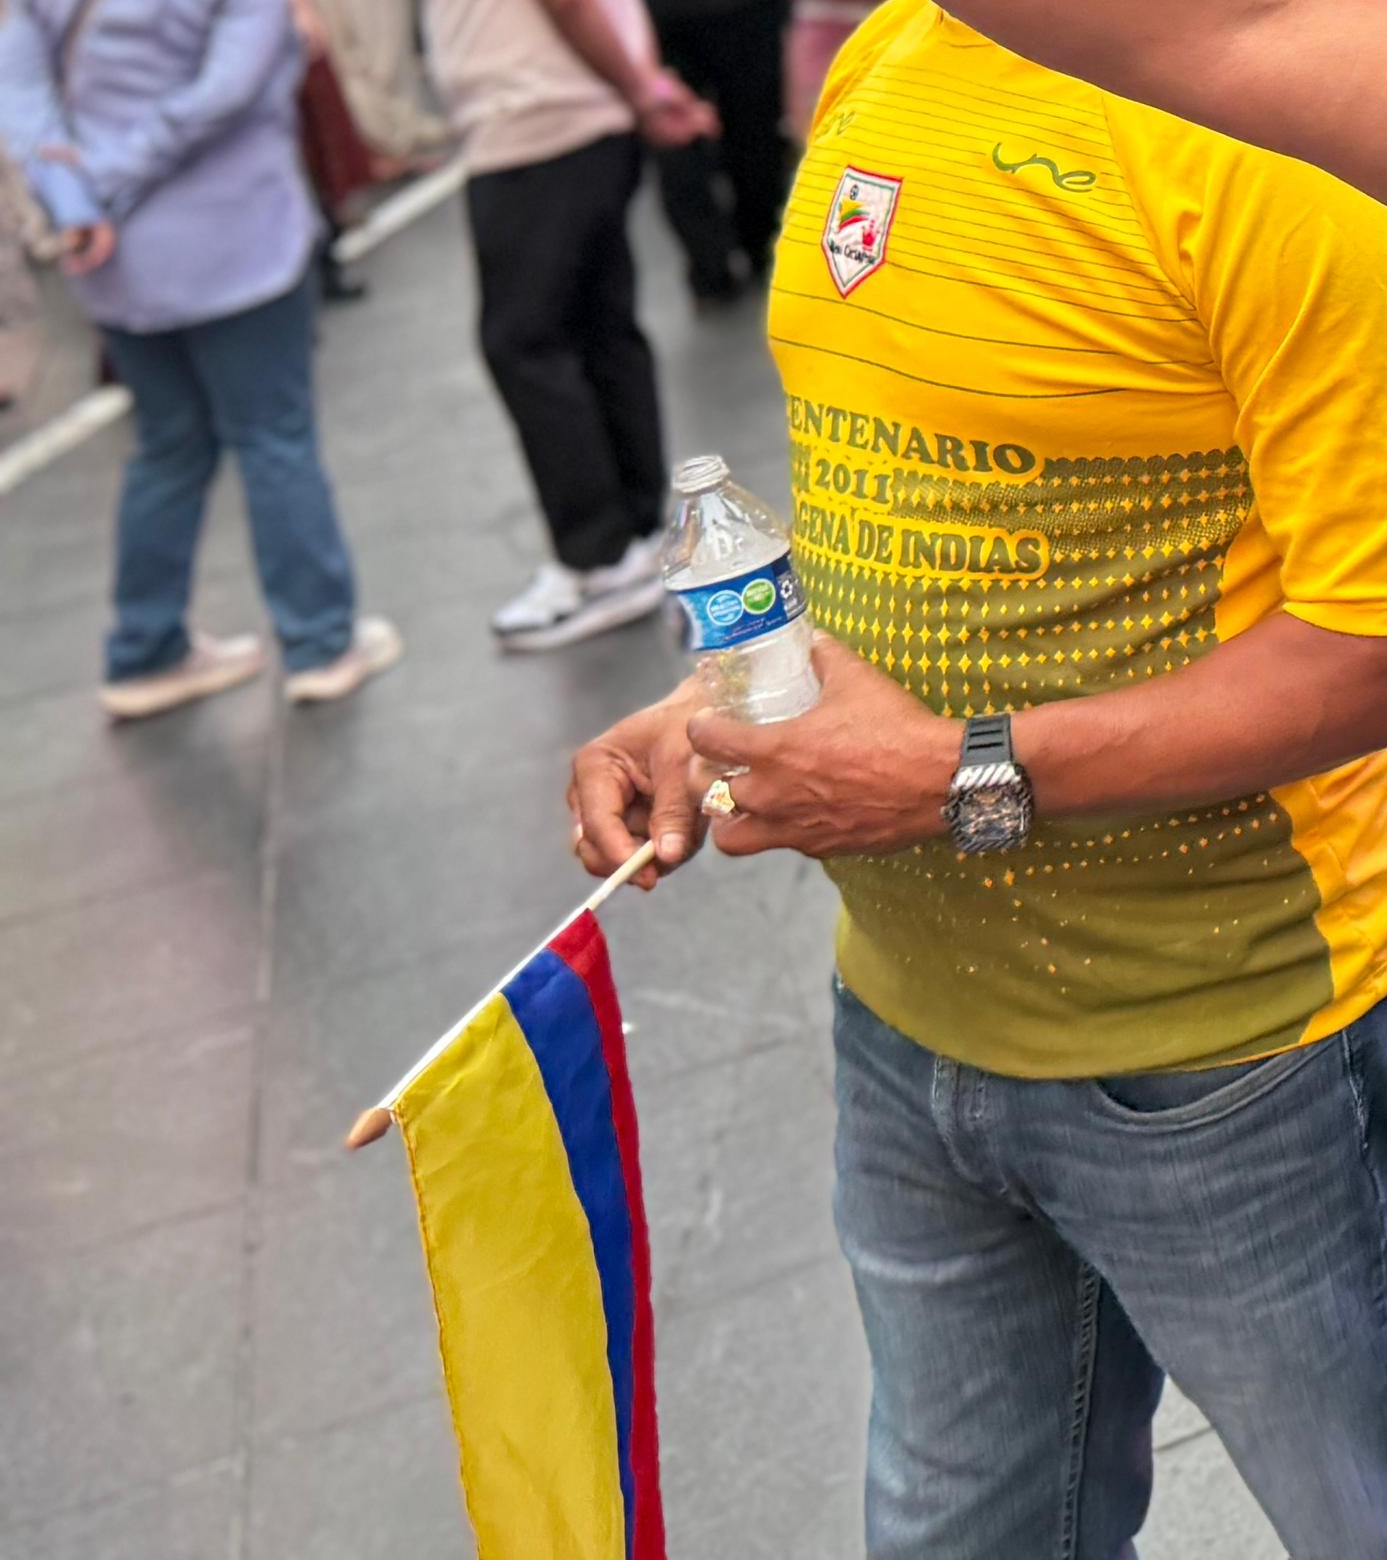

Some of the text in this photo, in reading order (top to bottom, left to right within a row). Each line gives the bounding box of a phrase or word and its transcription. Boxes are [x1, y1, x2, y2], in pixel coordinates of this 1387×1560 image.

[815, 458, 893, 506] 2011
[855, 517, 894, 566] DE
[897, 528, 1043, 576] INDIAS
